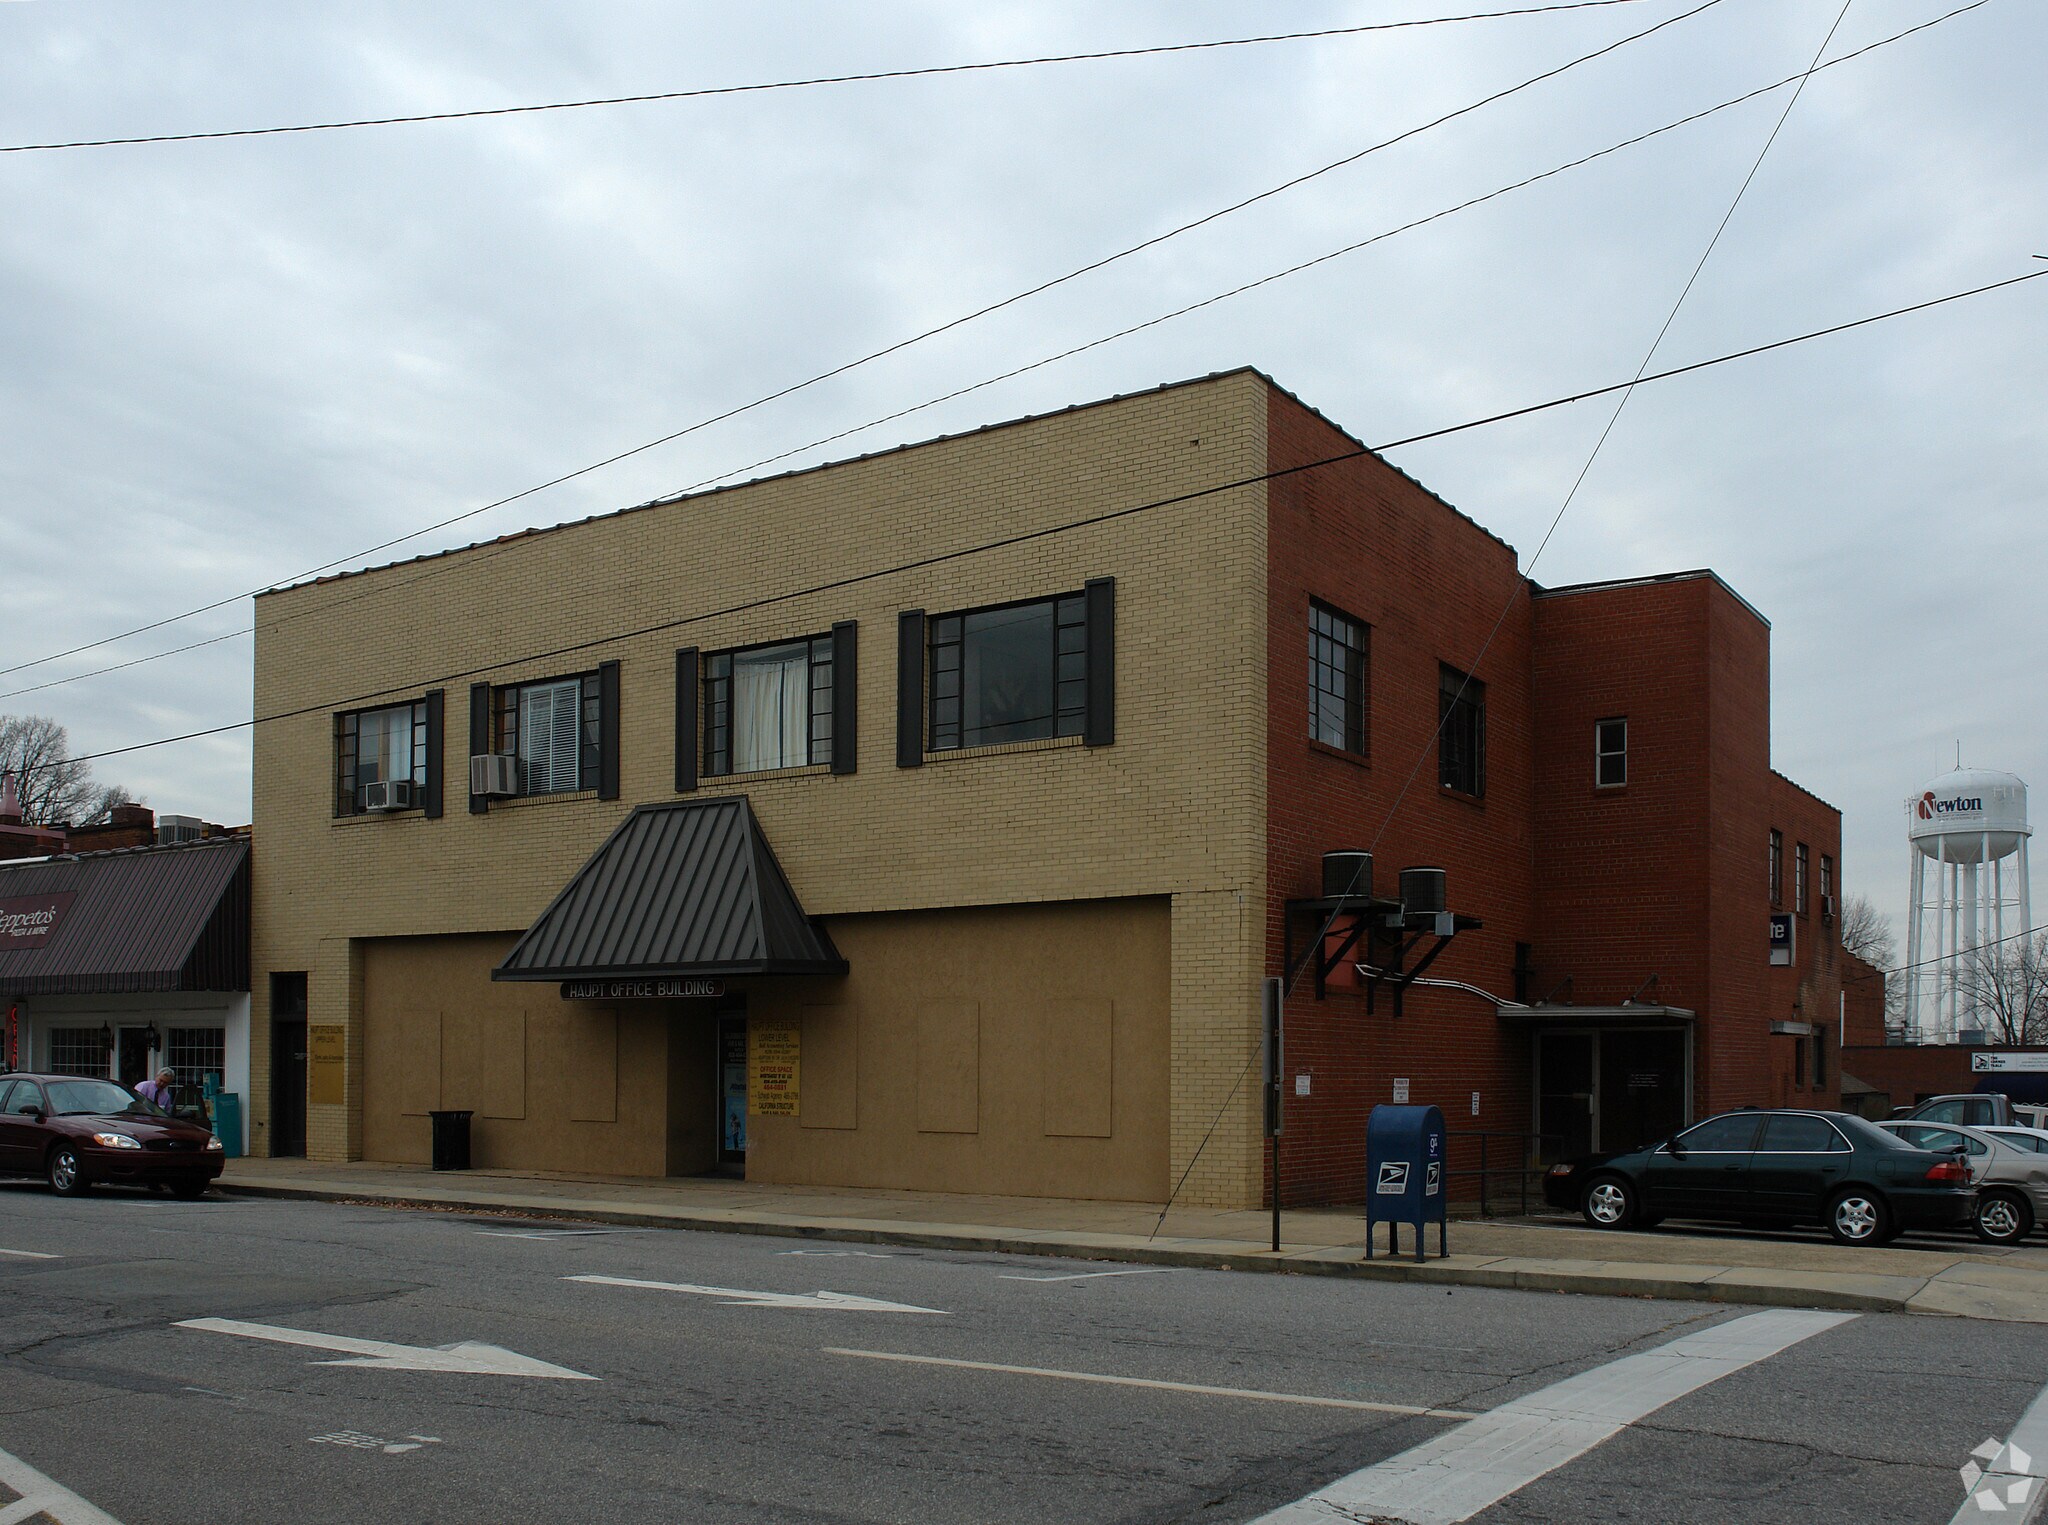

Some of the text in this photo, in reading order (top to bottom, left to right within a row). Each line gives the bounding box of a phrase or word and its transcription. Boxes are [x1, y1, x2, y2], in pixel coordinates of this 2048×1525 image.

[1923, 796, 1983, 820] Newton
[570, 980, 715, 998] HAUPT OFFICE BUILDING
